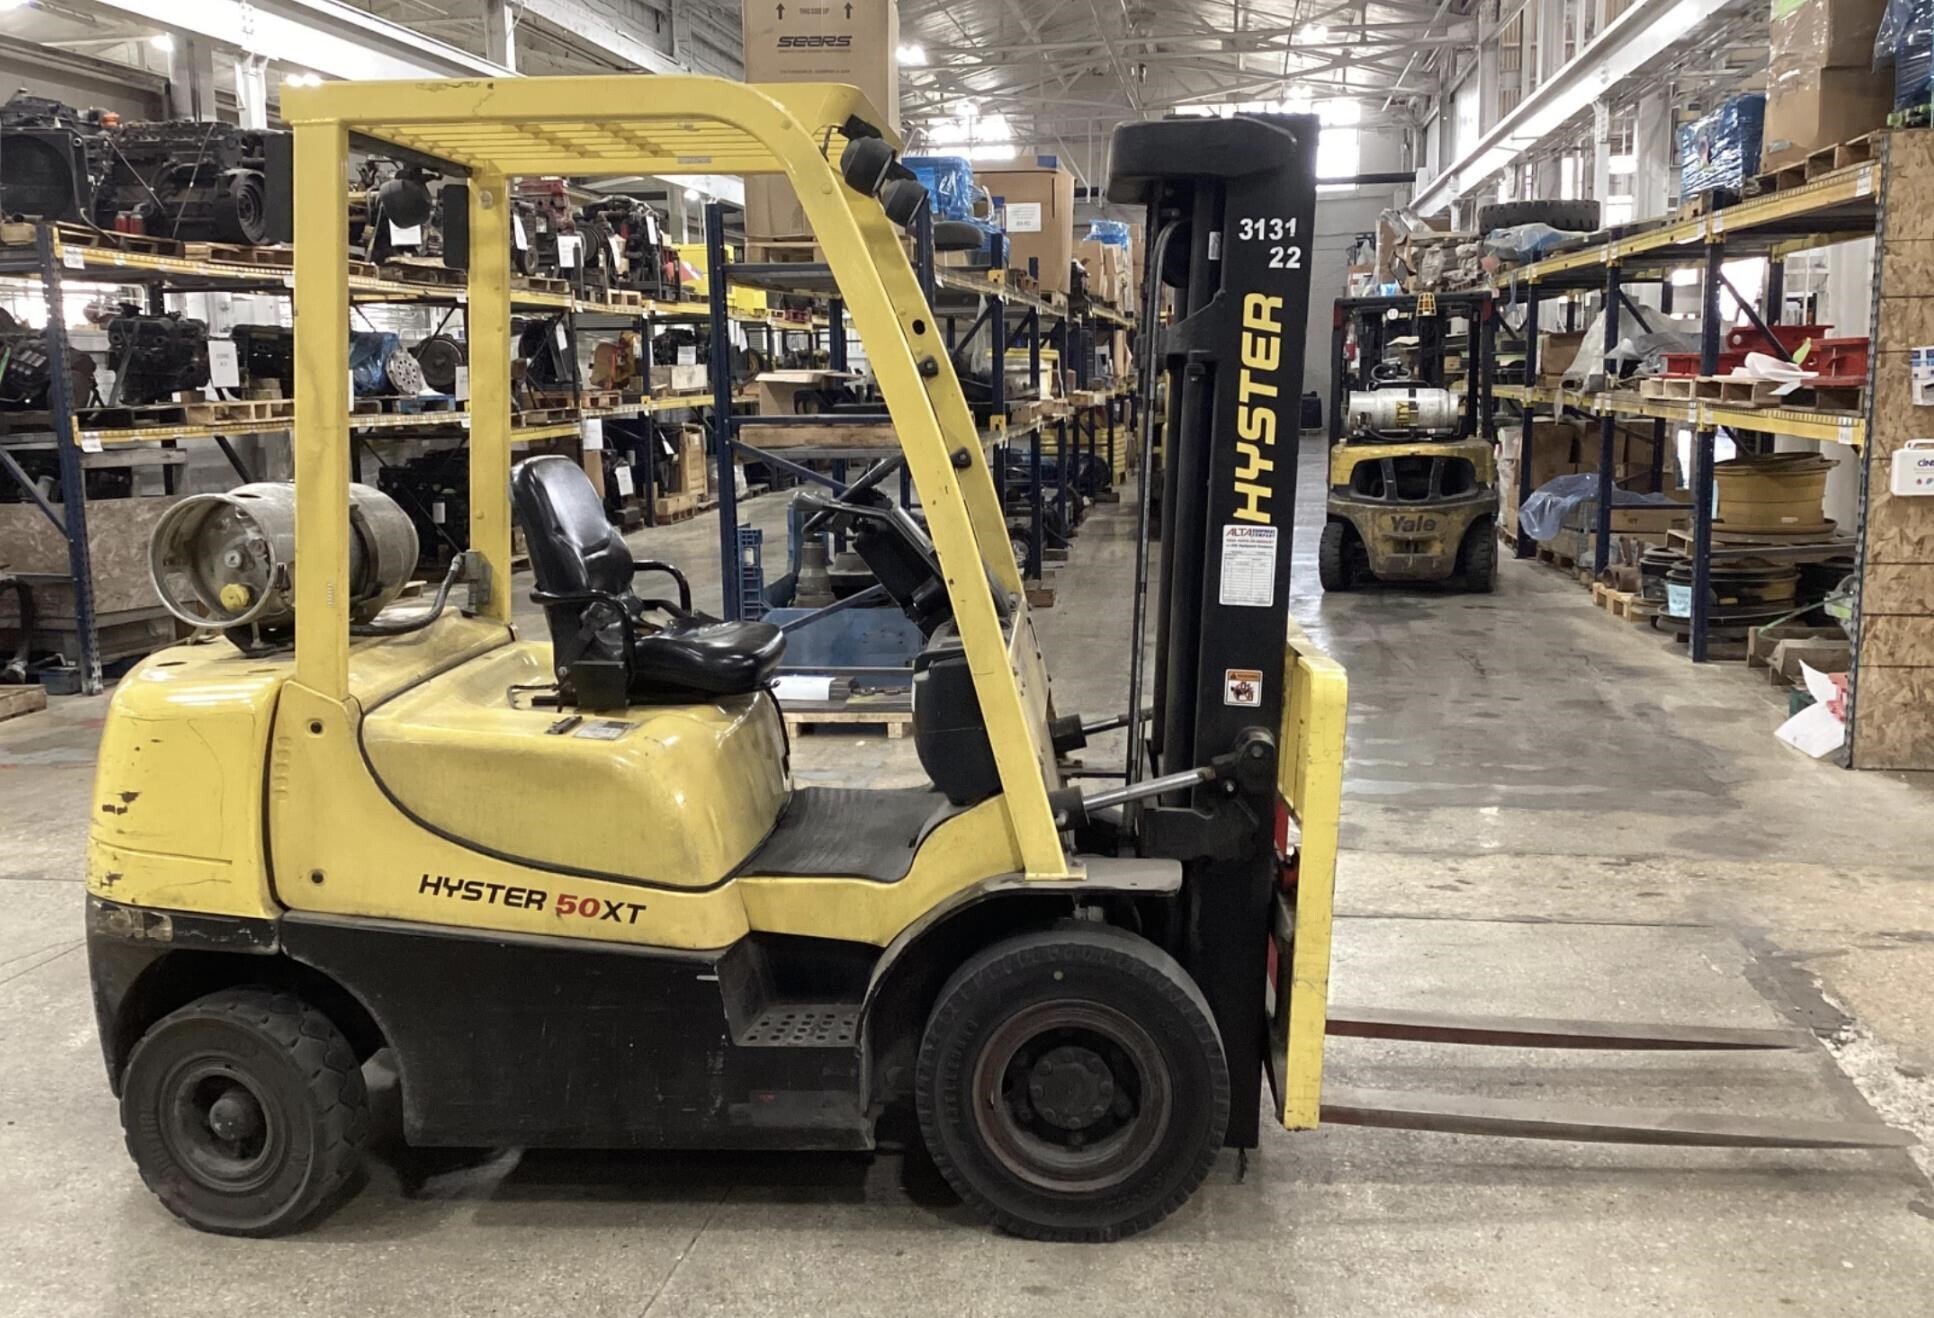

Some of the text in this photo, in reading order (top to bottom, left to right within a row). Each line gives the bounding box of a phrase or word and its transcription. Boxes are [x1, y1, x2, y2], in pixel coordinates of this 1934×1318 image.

[776, 36, 852, 47] SEARS
[1239, 217, 1297, 240] 3131
[1268, 246, 1301, 268] 22
[1233, 292, 1283, 524] HYSTER
[1226, 527, 1251, 537] ALTA
[1391, 515, 1436, 532] Yale
[418, 874, 647, 924] HYSTER 50XT
